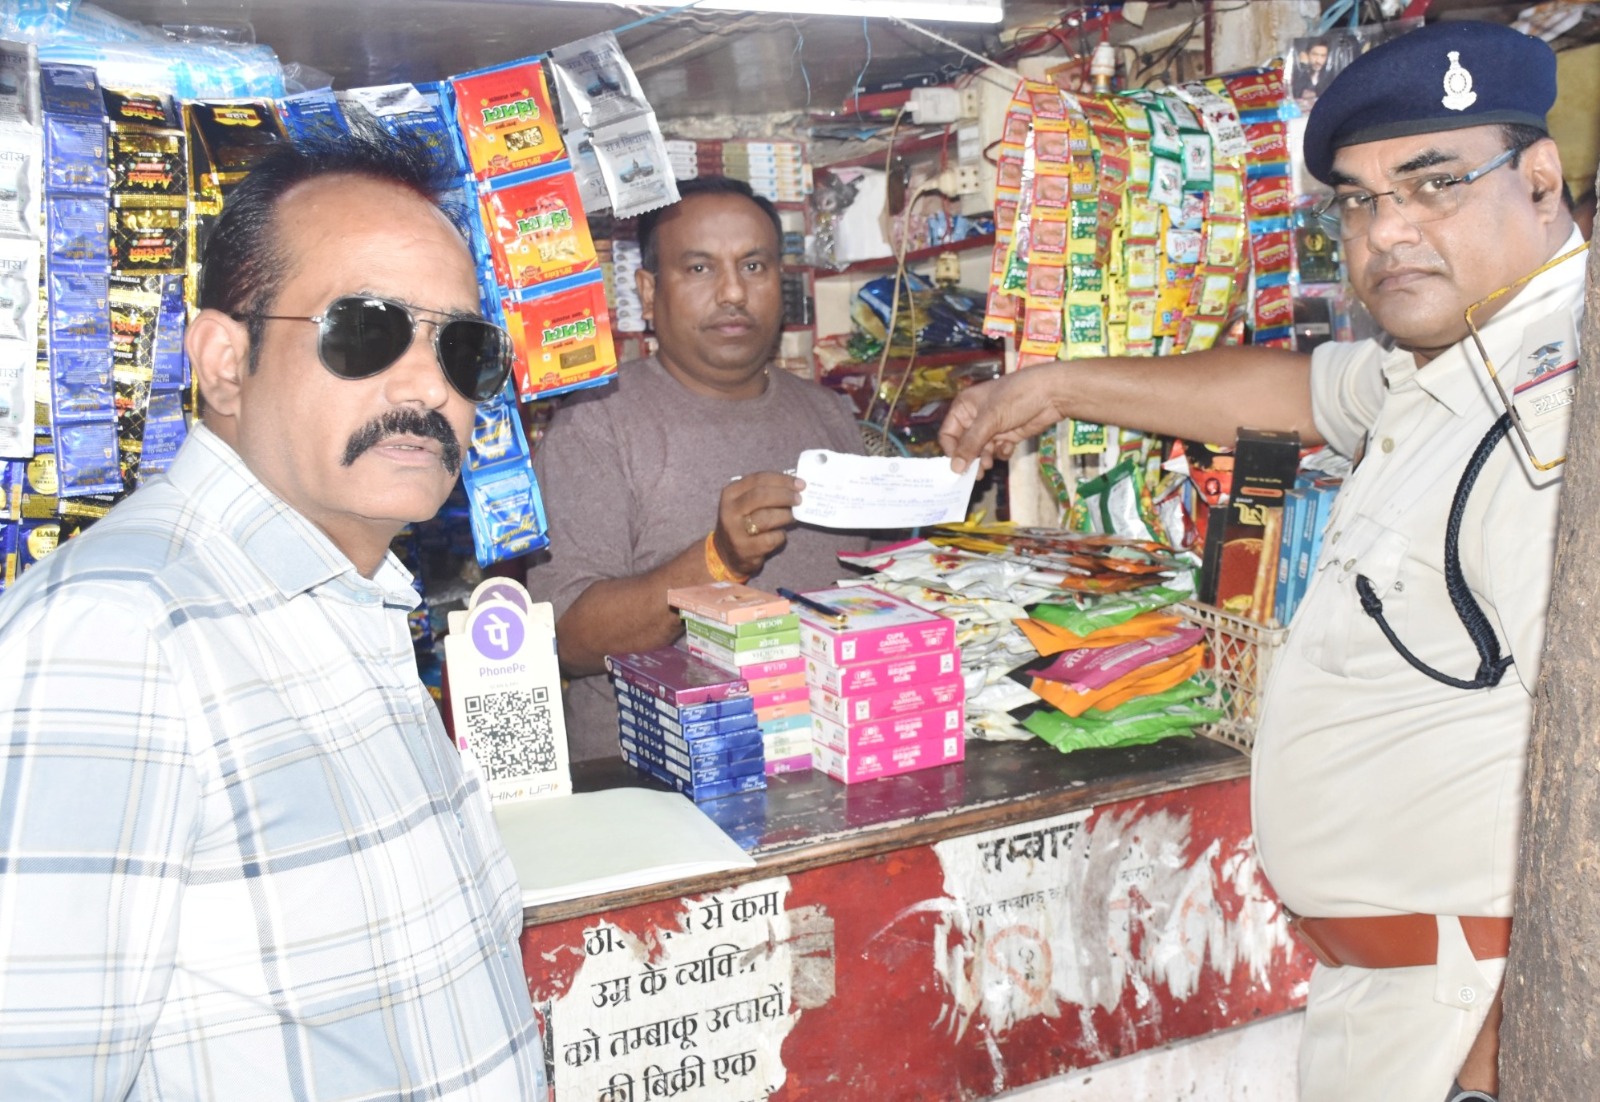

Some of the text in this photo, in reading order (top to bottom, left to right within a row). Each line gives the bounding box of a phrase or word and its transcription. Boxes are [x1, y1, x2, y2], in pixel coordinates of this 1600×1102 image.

[484, 613, 510, 652] पे
[479, 663, 526, 677] PhonePe
[491, 784, 554, 800] HIM UPI
[699, 897, 724, 930] से
[731, 891, 780, 922] कम
[591, 975, 631, 1008] उम्र
[638, 962, 668, 996] के
[562, 982, 785, 1068] को तम्बाकू उत्पादों
[598, 1072, 636, 1102] की
[643, 1055, 706, 1102] बिक्री
[713, 1049, 758, 1083] एक
